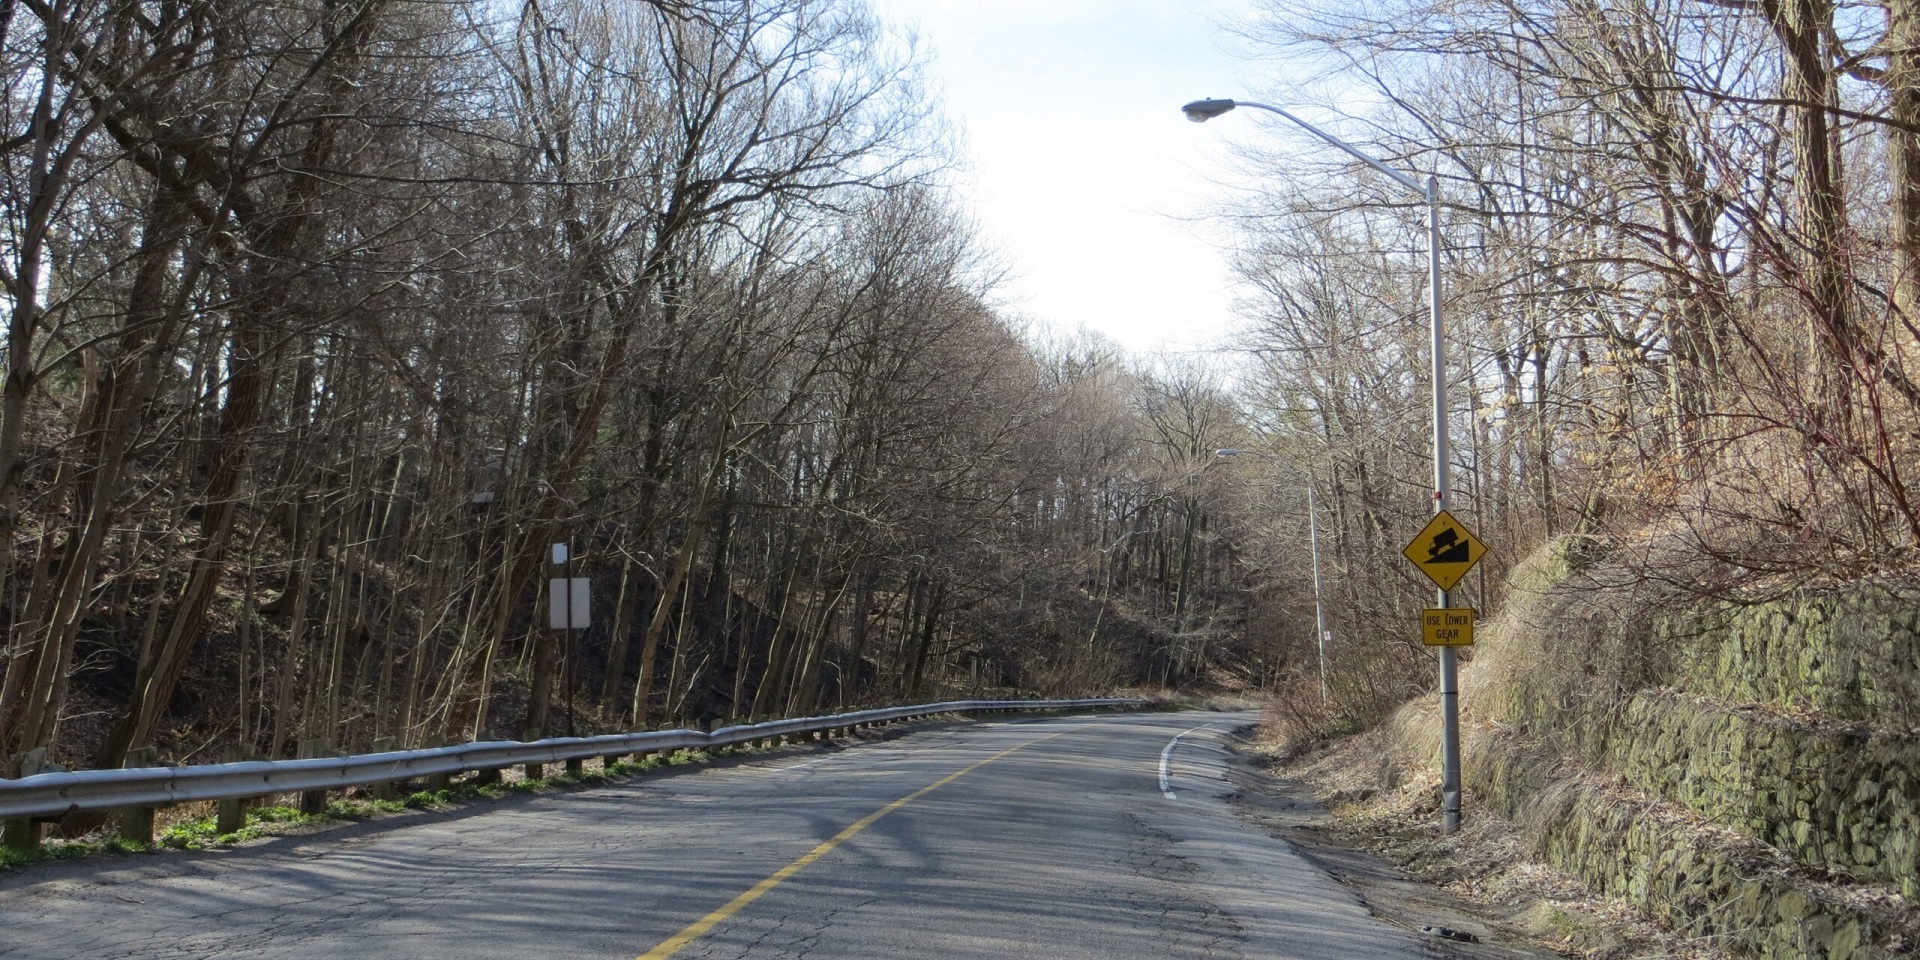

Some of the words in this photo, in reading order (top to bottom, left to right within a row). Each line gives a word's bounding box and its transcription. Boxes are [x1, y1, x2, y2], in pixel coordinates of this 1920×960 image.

[1426, 616, 1440, 626] USE
[1445, 615, 1468, 626] LOWER
[1436, 629, 1459, 639] GEAR
